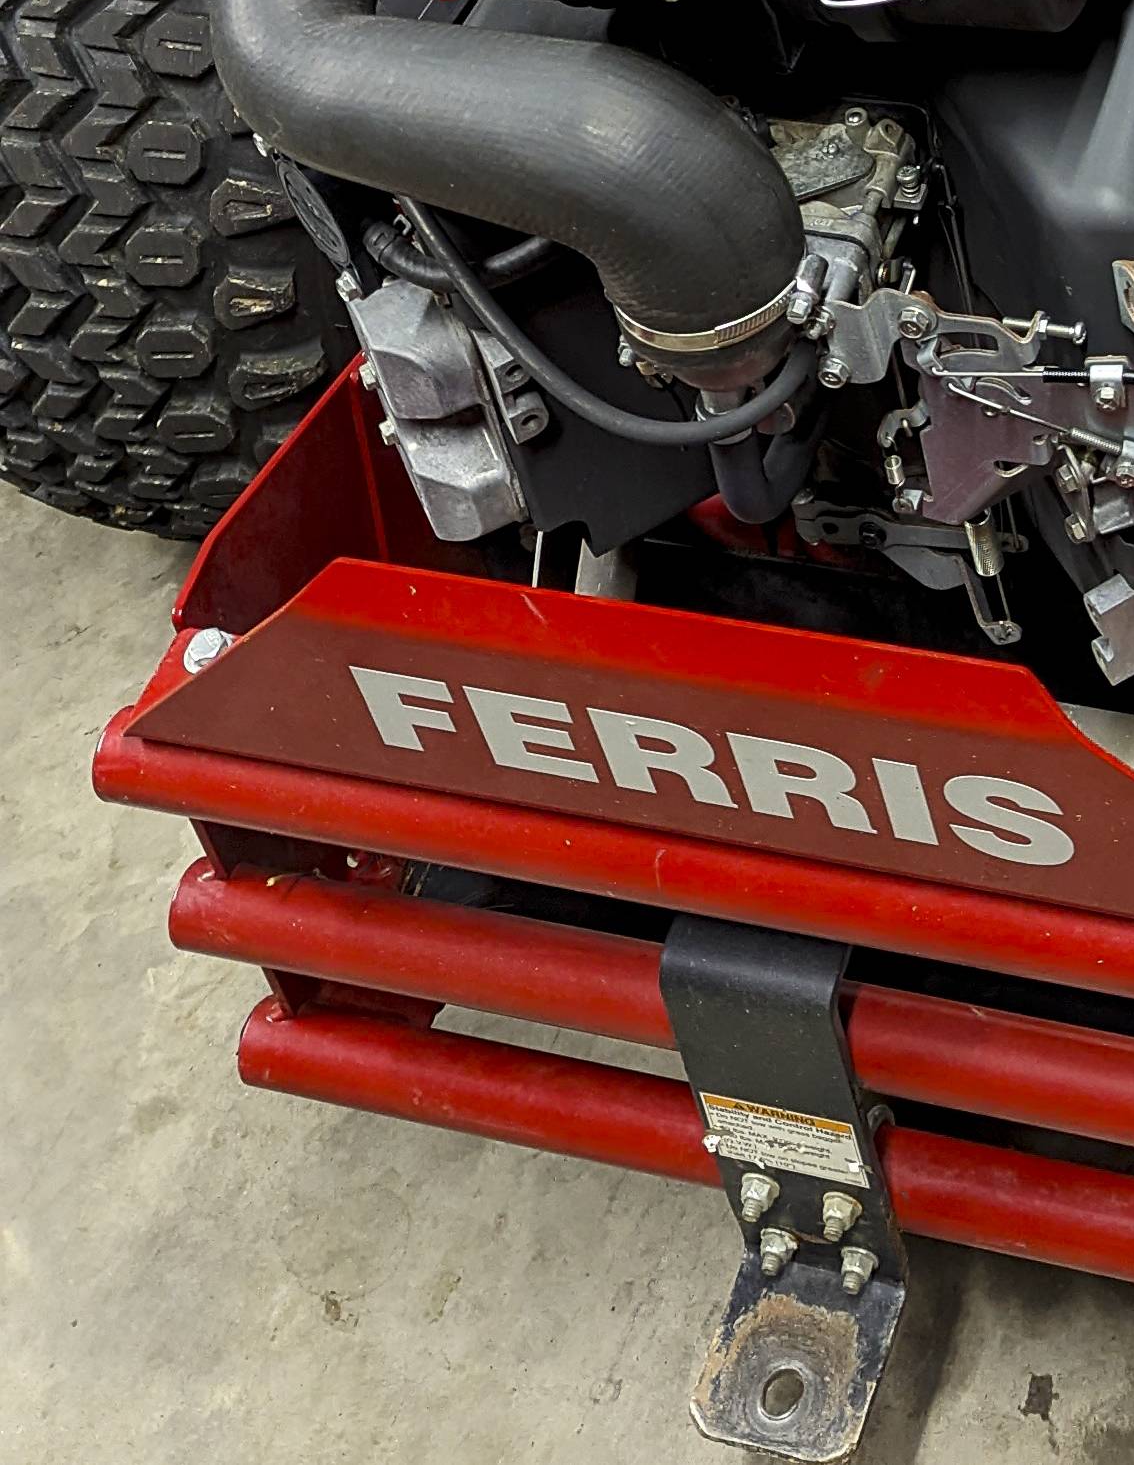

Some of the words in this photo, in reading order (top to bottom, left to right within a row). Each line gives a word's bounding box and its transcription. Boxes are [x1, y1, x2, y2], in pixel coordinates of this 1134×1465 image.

[348, 665, 1076, 866] FERRIS
[709, 1104, 748, 1118] Stability
[775, 1119, 812, 1132] Control
[746, 1104, 816, 1126] WARNING
